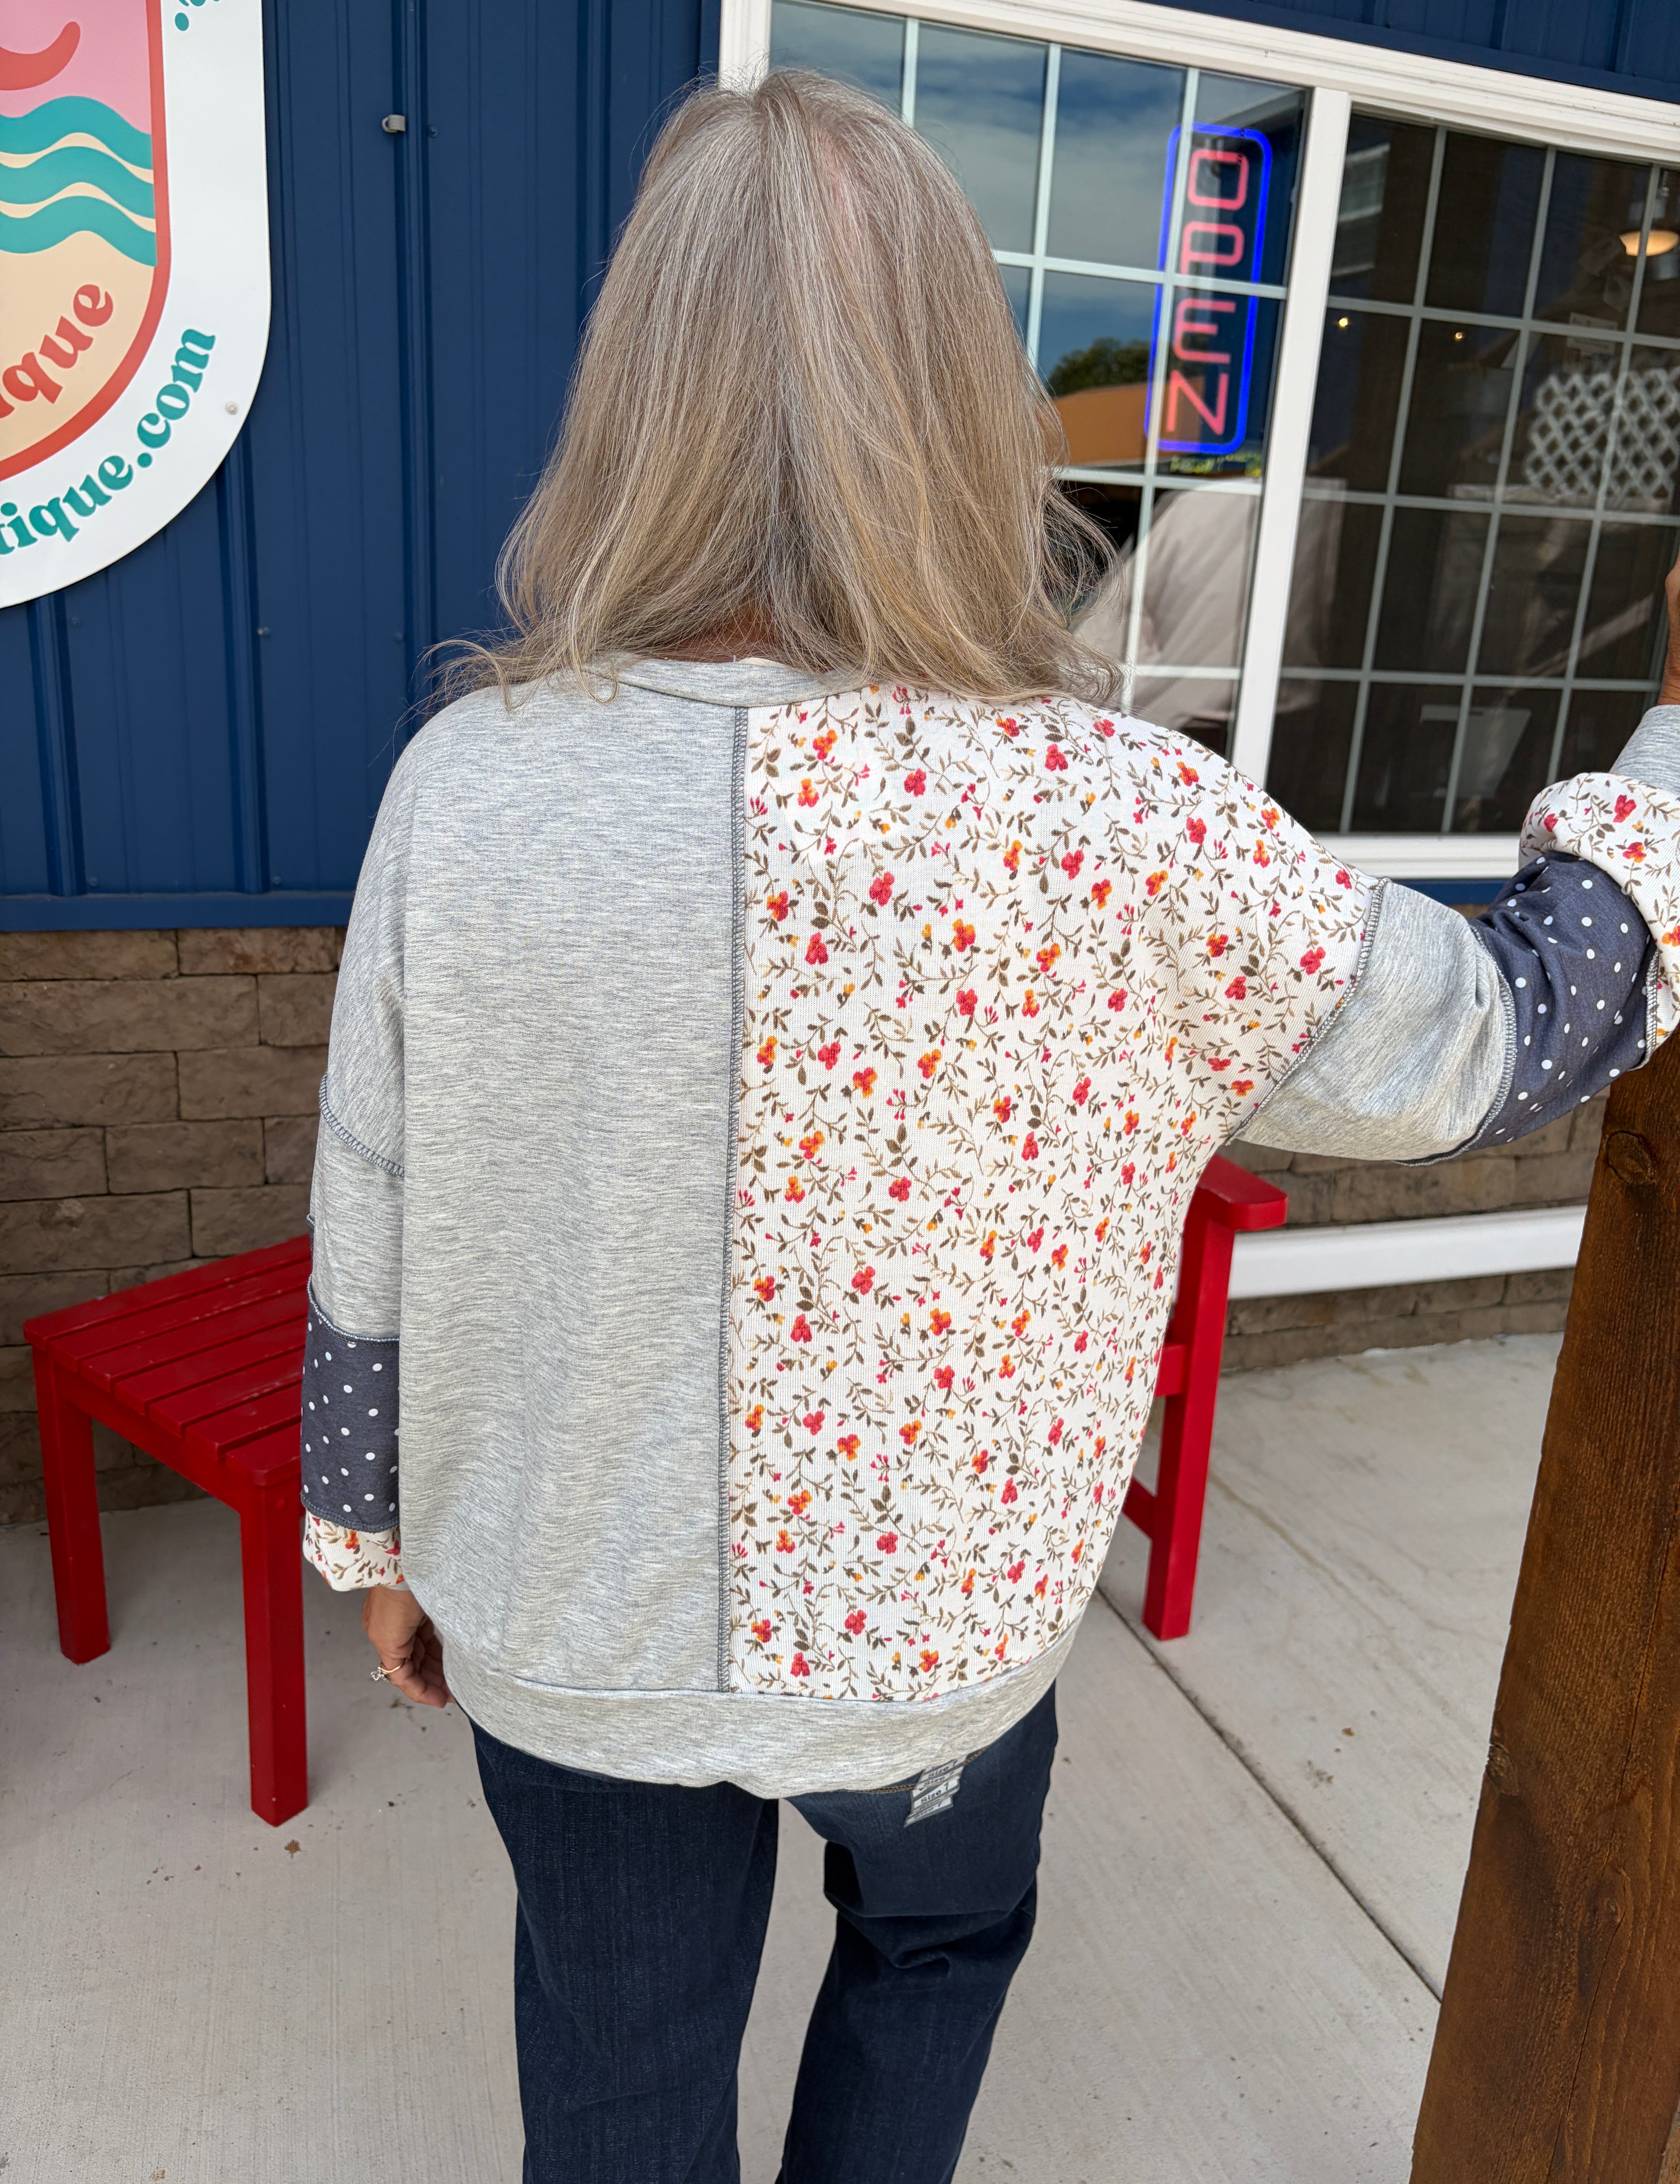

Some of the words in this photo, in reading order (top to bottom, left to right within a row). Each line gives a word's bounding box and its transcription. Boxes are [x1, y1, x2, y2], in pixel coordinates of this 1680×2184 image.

[1166, 149, 1249, 435] OPEN
[0, 284, 113, 418] que
[928, 1766, 949, 1778] Size
[923, 1776, 945, 1787] Size
[920, 1789, 942, 1804] Size
